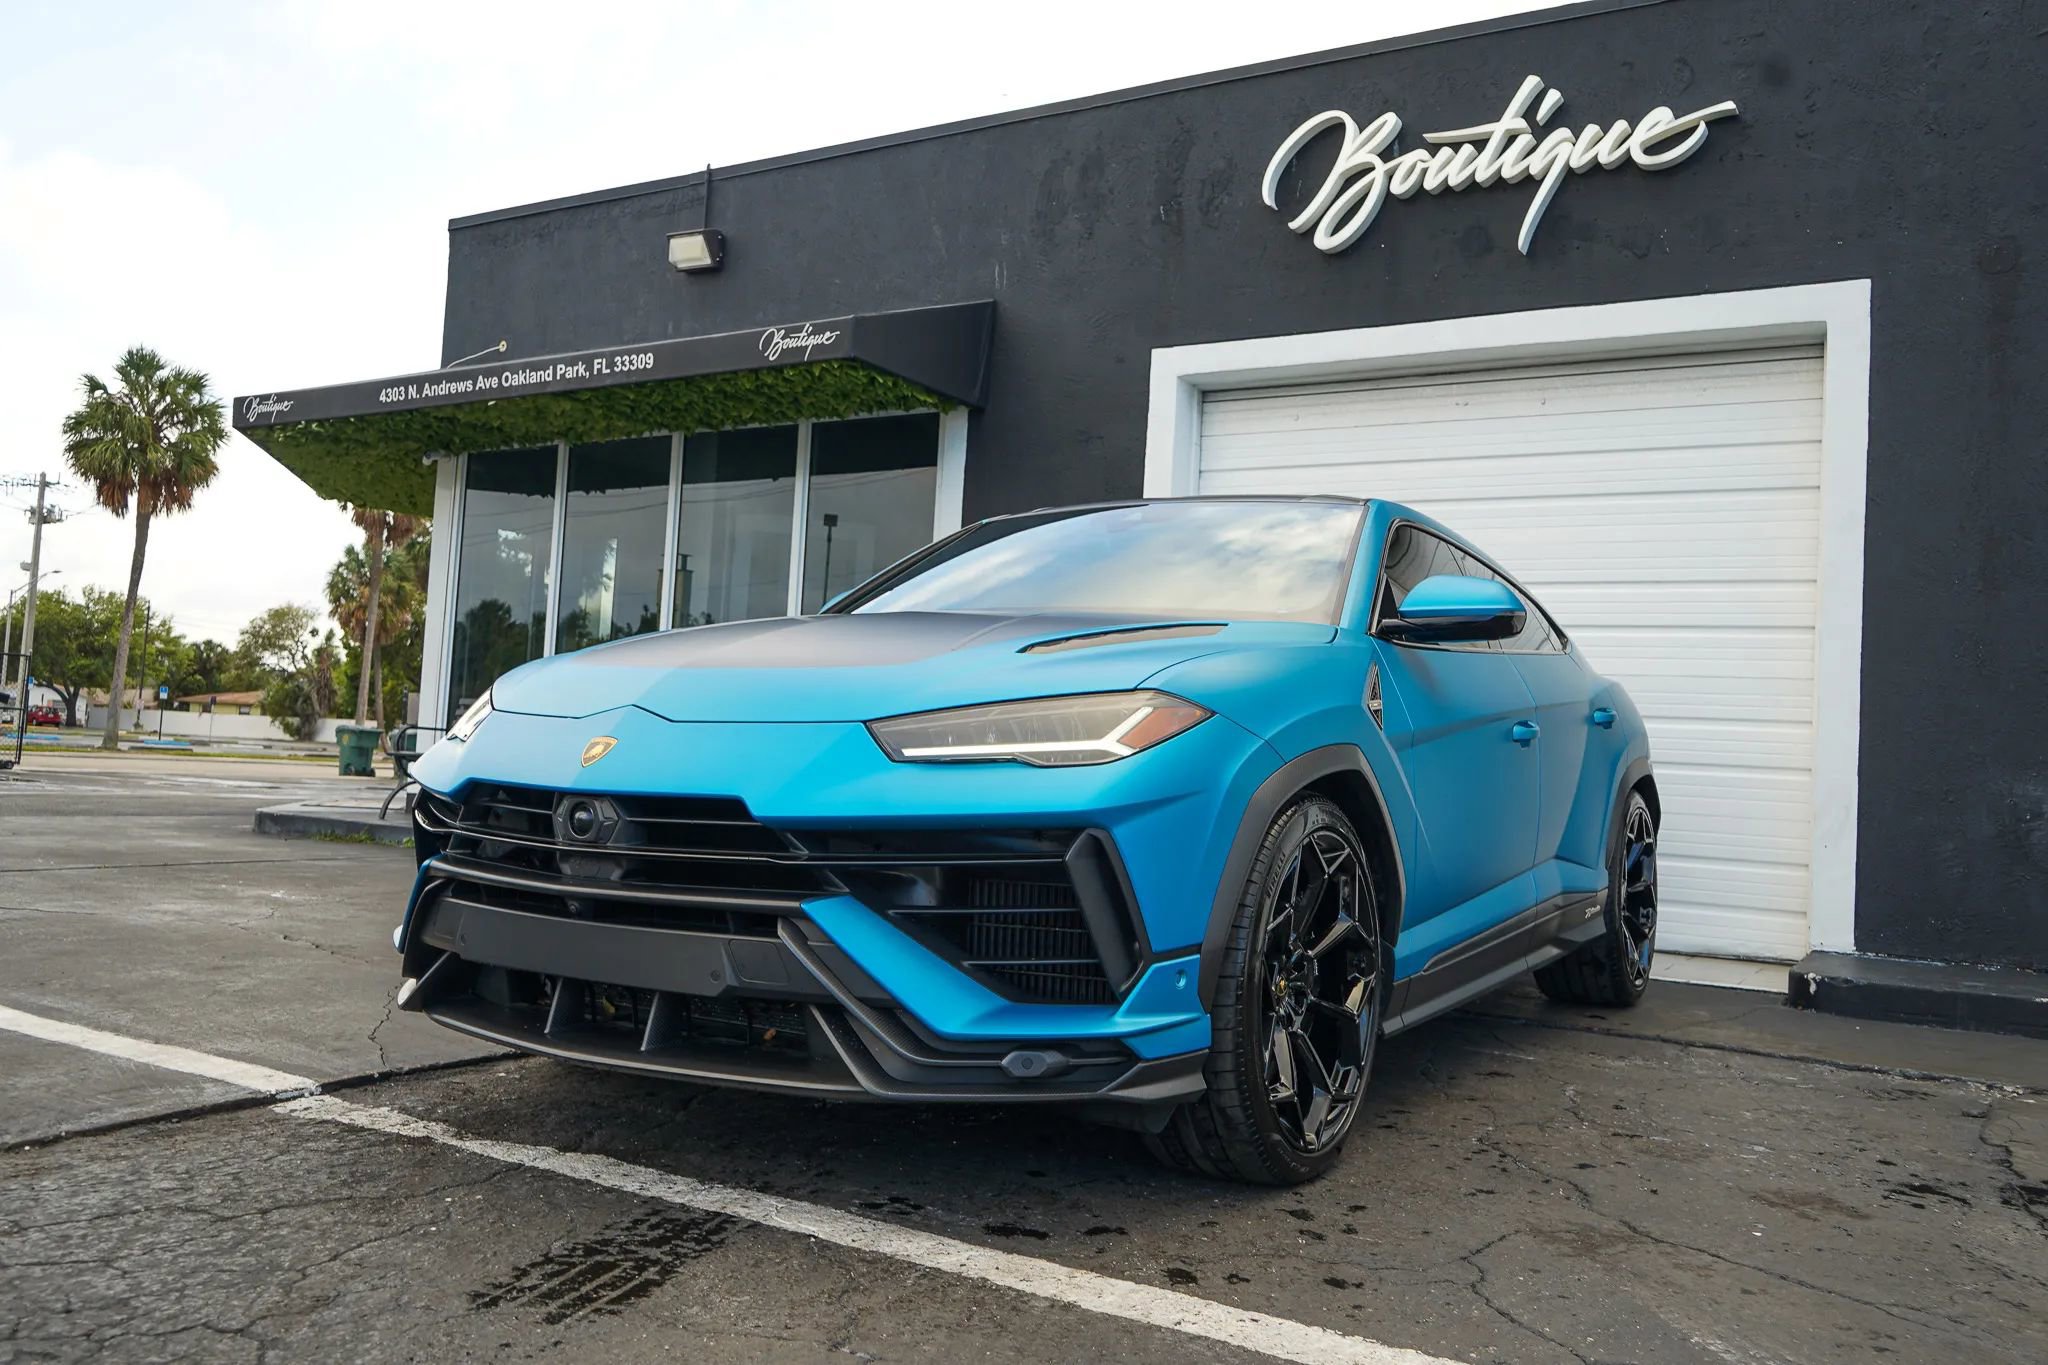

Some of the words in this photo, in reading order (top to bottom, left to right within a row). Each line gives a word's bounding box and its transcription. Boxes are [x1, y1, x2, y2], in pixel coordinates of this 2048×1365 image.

[1261, 74, 1739, 256] Boutique
[759, 323, 840, 362] Boutique
[379, 386, 405, 403] 4303
[407, 384, 420, 400] N.
[422, 380, 473, 398] Andrews
[476, 375, 499, 390] Ave
[501, 365, 553, 387] Oakland
[556, 361, 590, 380] Park,
[593, 357, 611, 375] FL
[613, 352, 654, 372] 33309
[243, 393, 294, 424] Boutique
